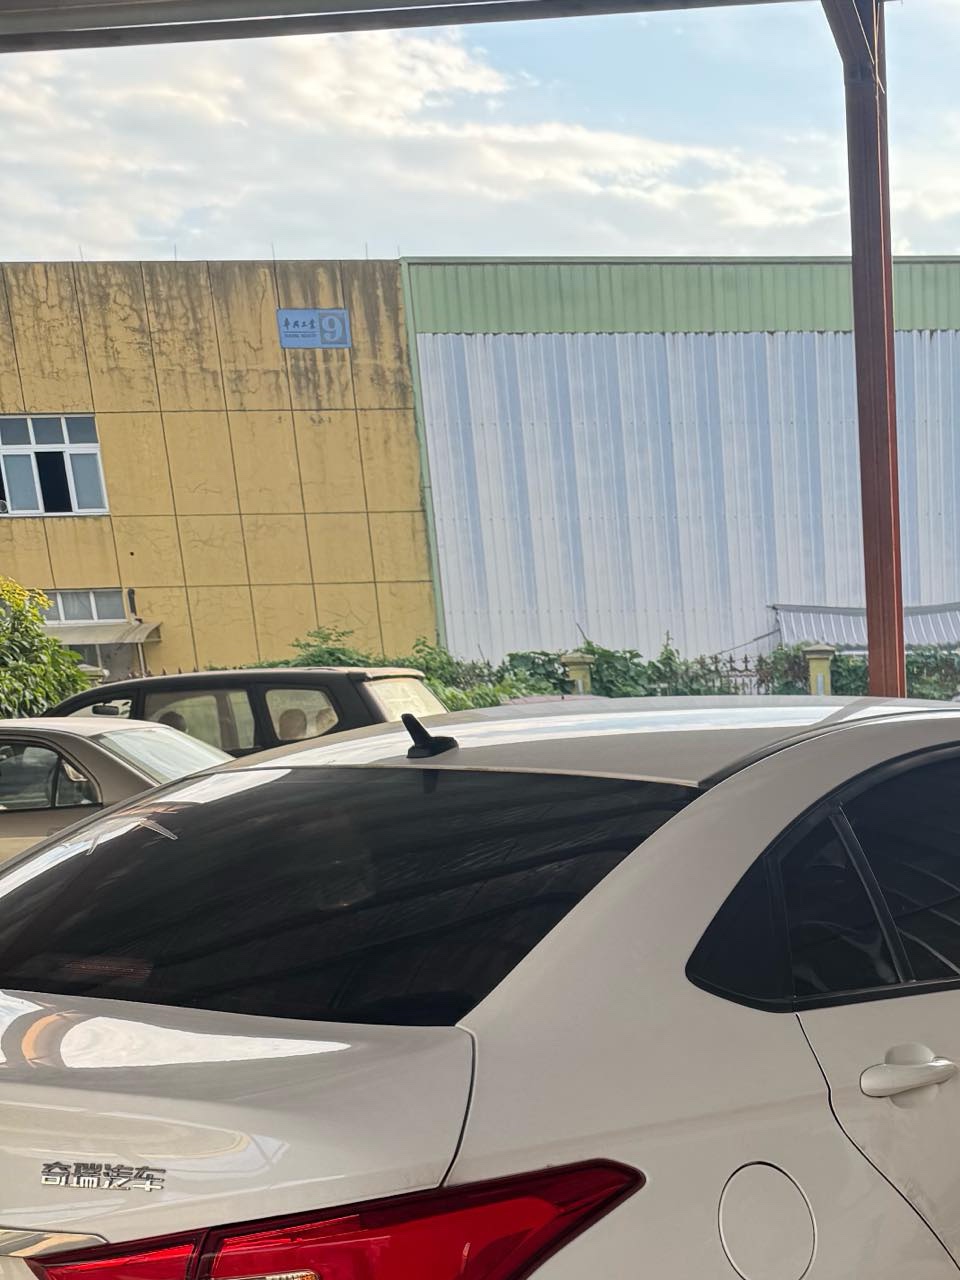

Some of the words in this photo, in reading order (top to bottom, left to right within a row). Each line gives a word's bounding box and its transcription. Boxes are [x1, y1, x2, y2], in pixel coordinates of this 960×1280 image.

[321, 315, 343, 342] 9
[41, 1161, 167, 1192] 奇瑞汽车
